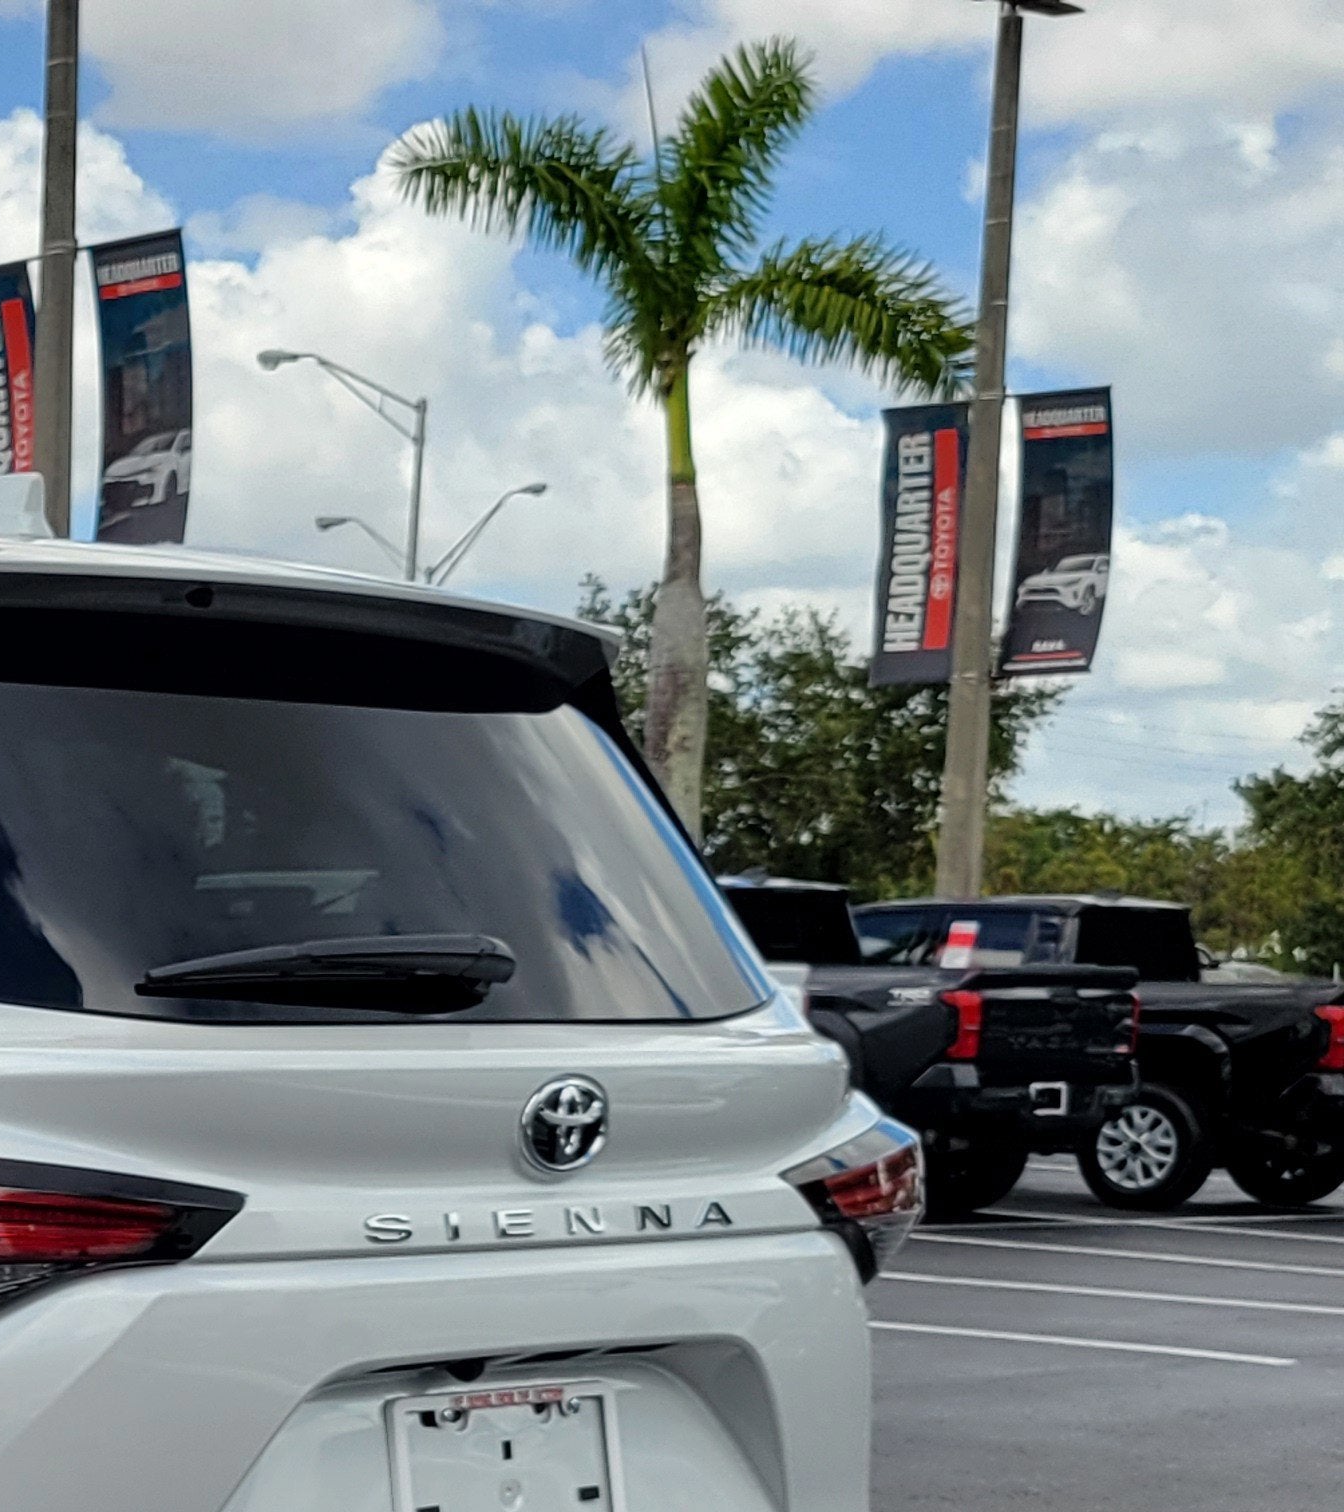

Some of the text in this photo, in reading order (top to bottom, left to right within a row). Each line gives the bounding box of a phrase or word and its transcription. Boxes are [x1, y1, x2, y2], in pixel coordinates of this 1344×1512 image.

[883, 430, 932, 652] HEADQUARTER
[932, 486, 956, 577] TOYOTA
[364, 1201, 734, 1243] SIENNA
